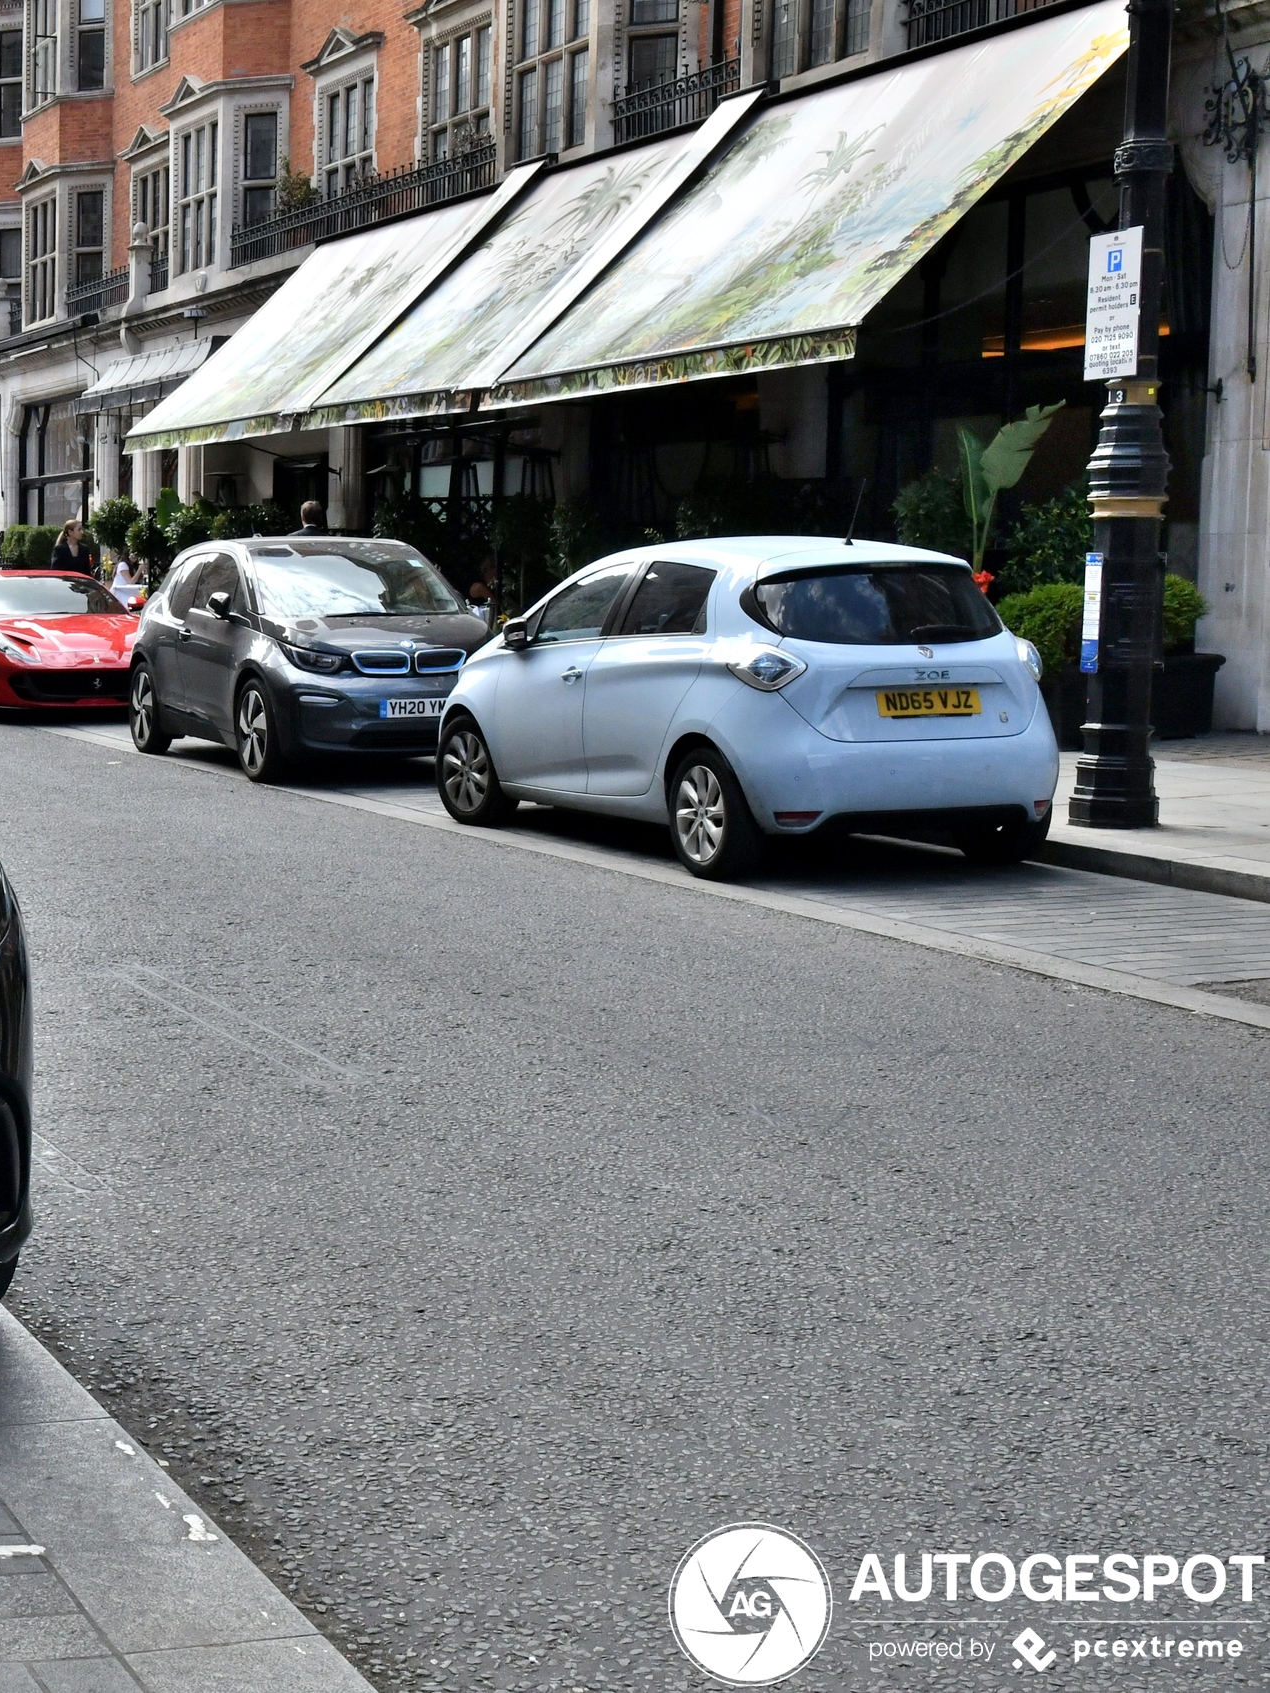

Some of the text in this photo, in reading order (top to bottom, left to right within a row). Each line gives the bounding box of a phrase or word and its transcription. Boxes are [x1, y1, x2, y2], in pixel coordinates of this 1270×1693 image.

[1111, 252, 1120, 270] P
[1098, 294, 1121, 303] Resident
[1090, 302, 1128, 314] permit holders
[1113, 324, 1130, 332] phone
[1118, 332, 1133, 340] 9090
[1090, 353, 1107, 361] 07860
[914, 670, 950, 680] ZOE
[885, 691, 973, 711] ND65 VJZ
[390, 701, 425, 715] YH20
